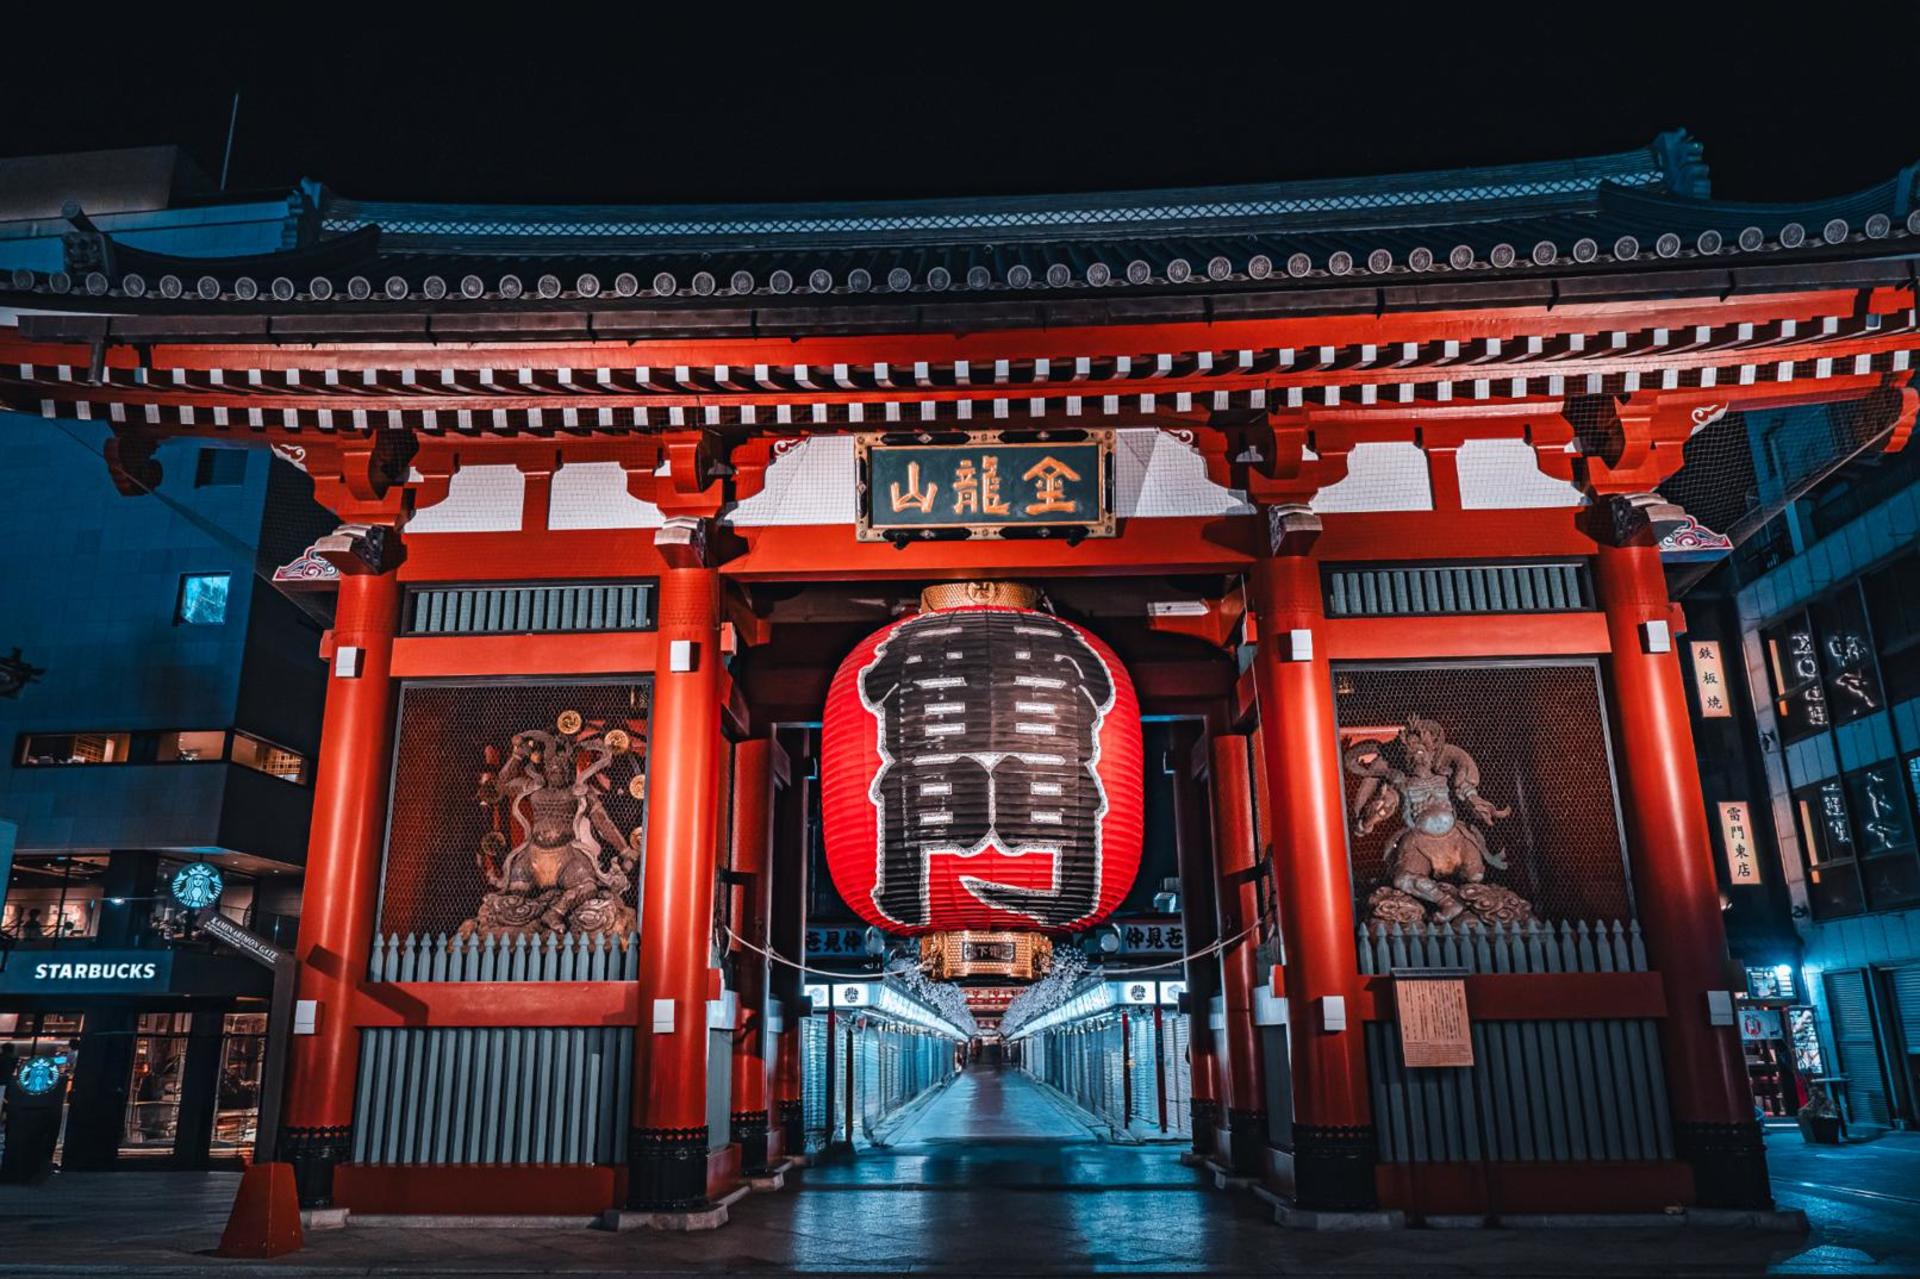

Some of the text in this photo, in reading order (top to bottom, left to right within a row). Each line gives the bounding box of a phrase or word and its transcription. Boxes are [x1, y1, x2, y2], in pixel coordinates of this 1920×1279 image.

[1699, 647, 1722, 709] 鉄板焼
[857, 610, 1116, 926] 雷門
[1727, 807, 1750, 877] 雷門東店
[210, 917, 260, 948] KAMINARIMON
[259, 945, 279, 960] GATE
[34, 963, 156, 979] STARBUCKS
